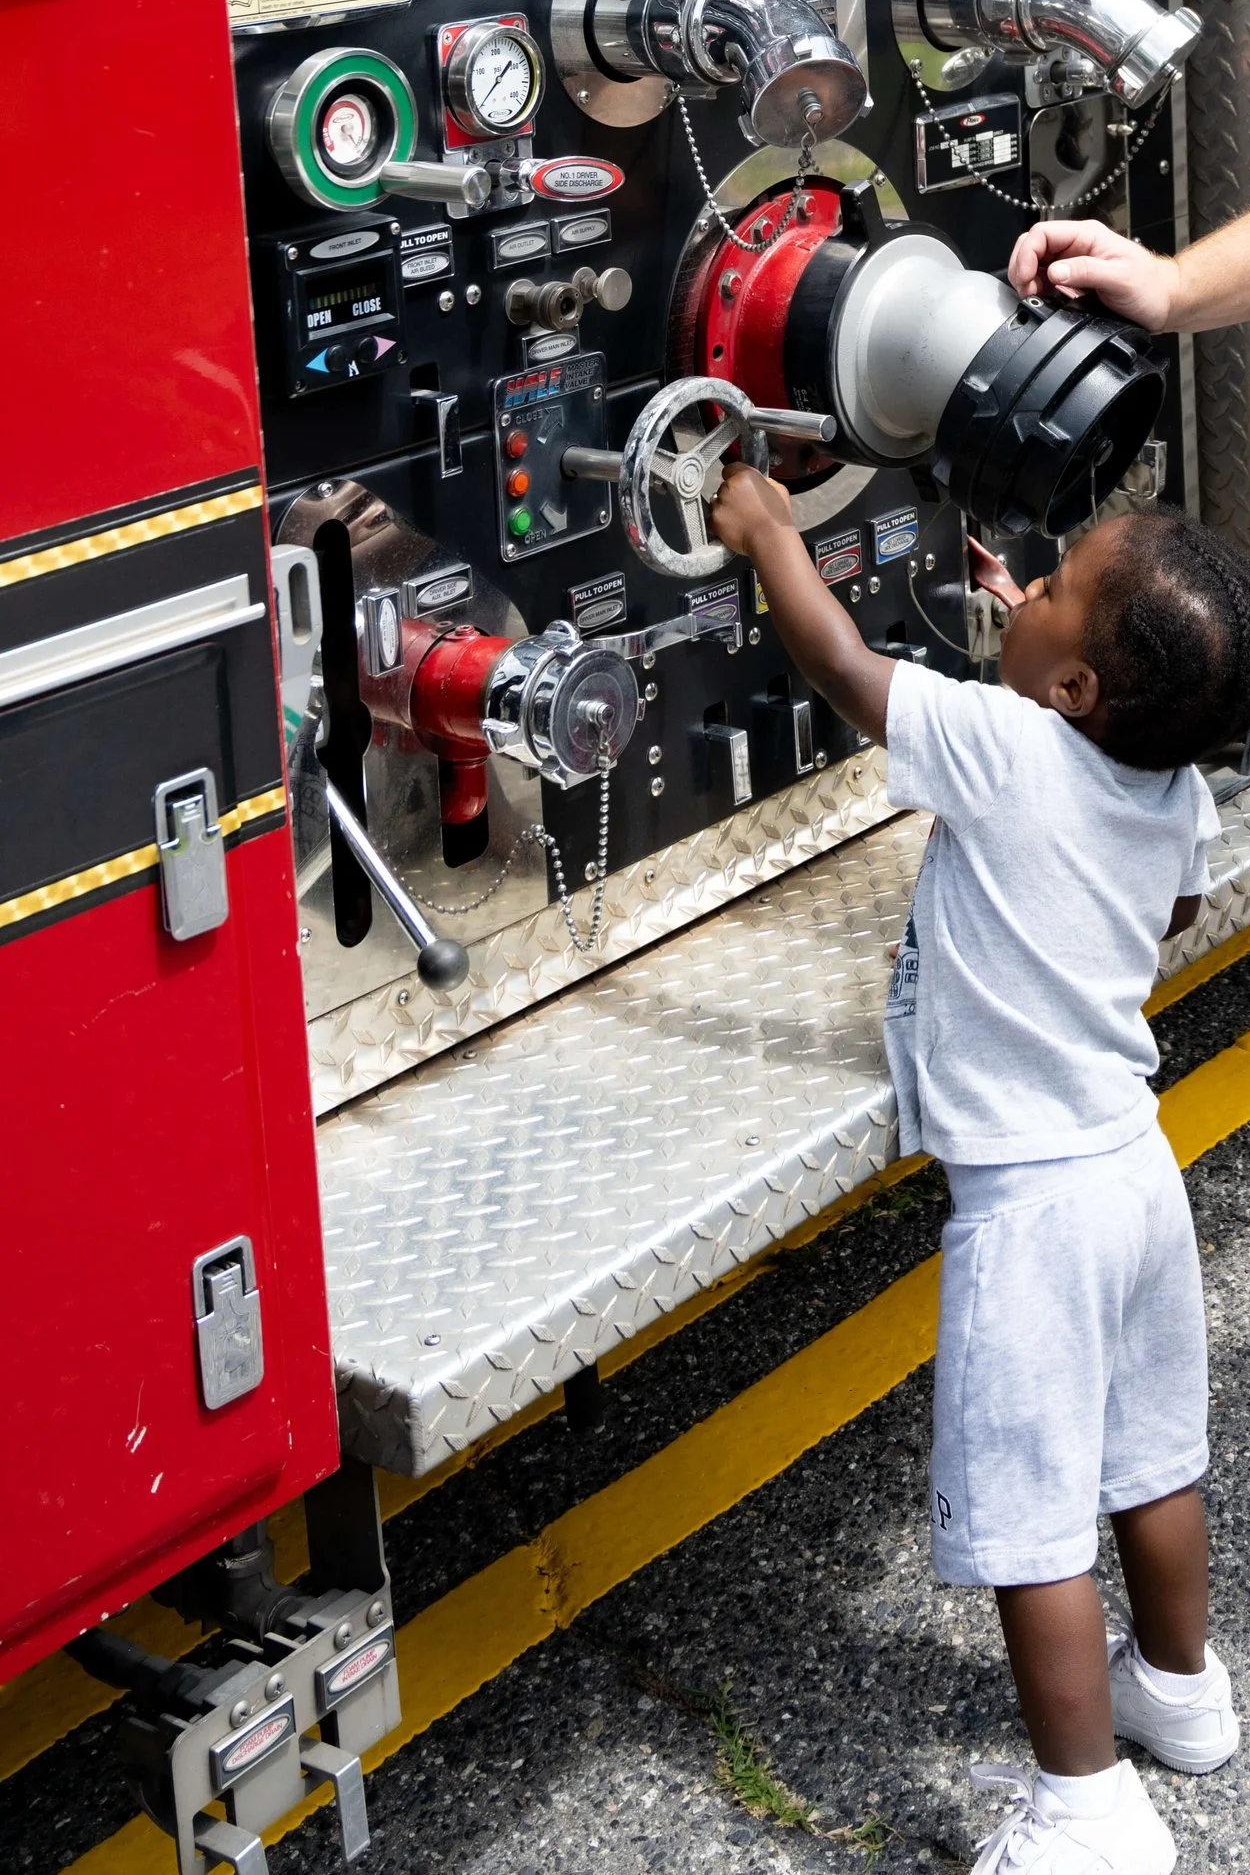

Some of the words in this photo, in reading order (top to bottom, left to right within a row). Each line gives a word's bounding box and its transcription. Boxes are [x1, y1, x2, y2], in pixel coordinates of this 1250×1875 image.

[491, 48, 501, 56] 200
[476, 67, 485, 75] 100
[493, 67, 501, 75] psi
[569, 179, 603, 188] DISCHARGE
[579, 225, 596, 234] SUPPLY
[328, 240, 344, 251] FRONT
[345, 237, 362, 248] INLET
[400, 236, 417, 249] ULL
[417, 234, 427, 245] TO
[426, 231, 448, 244] OPEN
[517, 239, 535, 249] OUTLET
[407, 260, 422, 271] FRONT
[423, 257, 437, 267] INLET
[419, 264, 436, 273] BLEED
[352, 297, 381, 316] CLOSE
[307, 309, 332, 328] OPEN
[531, 346, 548, 356] DRIVER
[549, 344, 560, 352] MAIN
[560, 341, 573, 349] INLET
[567, 358, 600, 372] MASTER
[566, 368, 594, 381] INTAKE
[504, 367, 563, 408] HALE
[565, 378, 588, 390] VALVE
[515, 410, 544, 425] CLOSE
[877, 522, 891, 533] PULL
[891, 518, 900, 527] TO
[899, 512, 915, 524] OPEN
[524, 529, 547, 545] OPEN
[818, 543, 833, 555] PULL
[833, 539, 842, 549] TO
[841, 533, 858, 546] OPEN
[429, 584, 445, 595] DRIVER
[446, 581, 457, 590] SIDE
[431, 593, 443, 601] AUX.
[443, 589, 456, 598] INLET
[575, 589, 592, 602] PULL
[593, 585, 603, 595] TO
[603, 578, 623, 593] OPEN
[691, 593, 708, 606] PULL
[708, 590, 718, 600] TO
[717, 584, 735, 596] OPEN
[580, 613, 595, 623] DRIVER
[595, 609, 606, 618] MAIN
[606, 605, 618, 614] INLET
[342, 1667, 360, 1682] INTAKE
[361, 1654, 378, 1669] DRAIN
[343, 1660, 360, 1675] FOAM
[359, 1649, 375, 1663] PUMP
[232, 1740, 264, 1764] DISCHARGE
[265, 1723, 283, 1740] DRAIN
[239, 1736, 256, 1751] FOAM
[256, 1725, 273, 1739] PUMP
